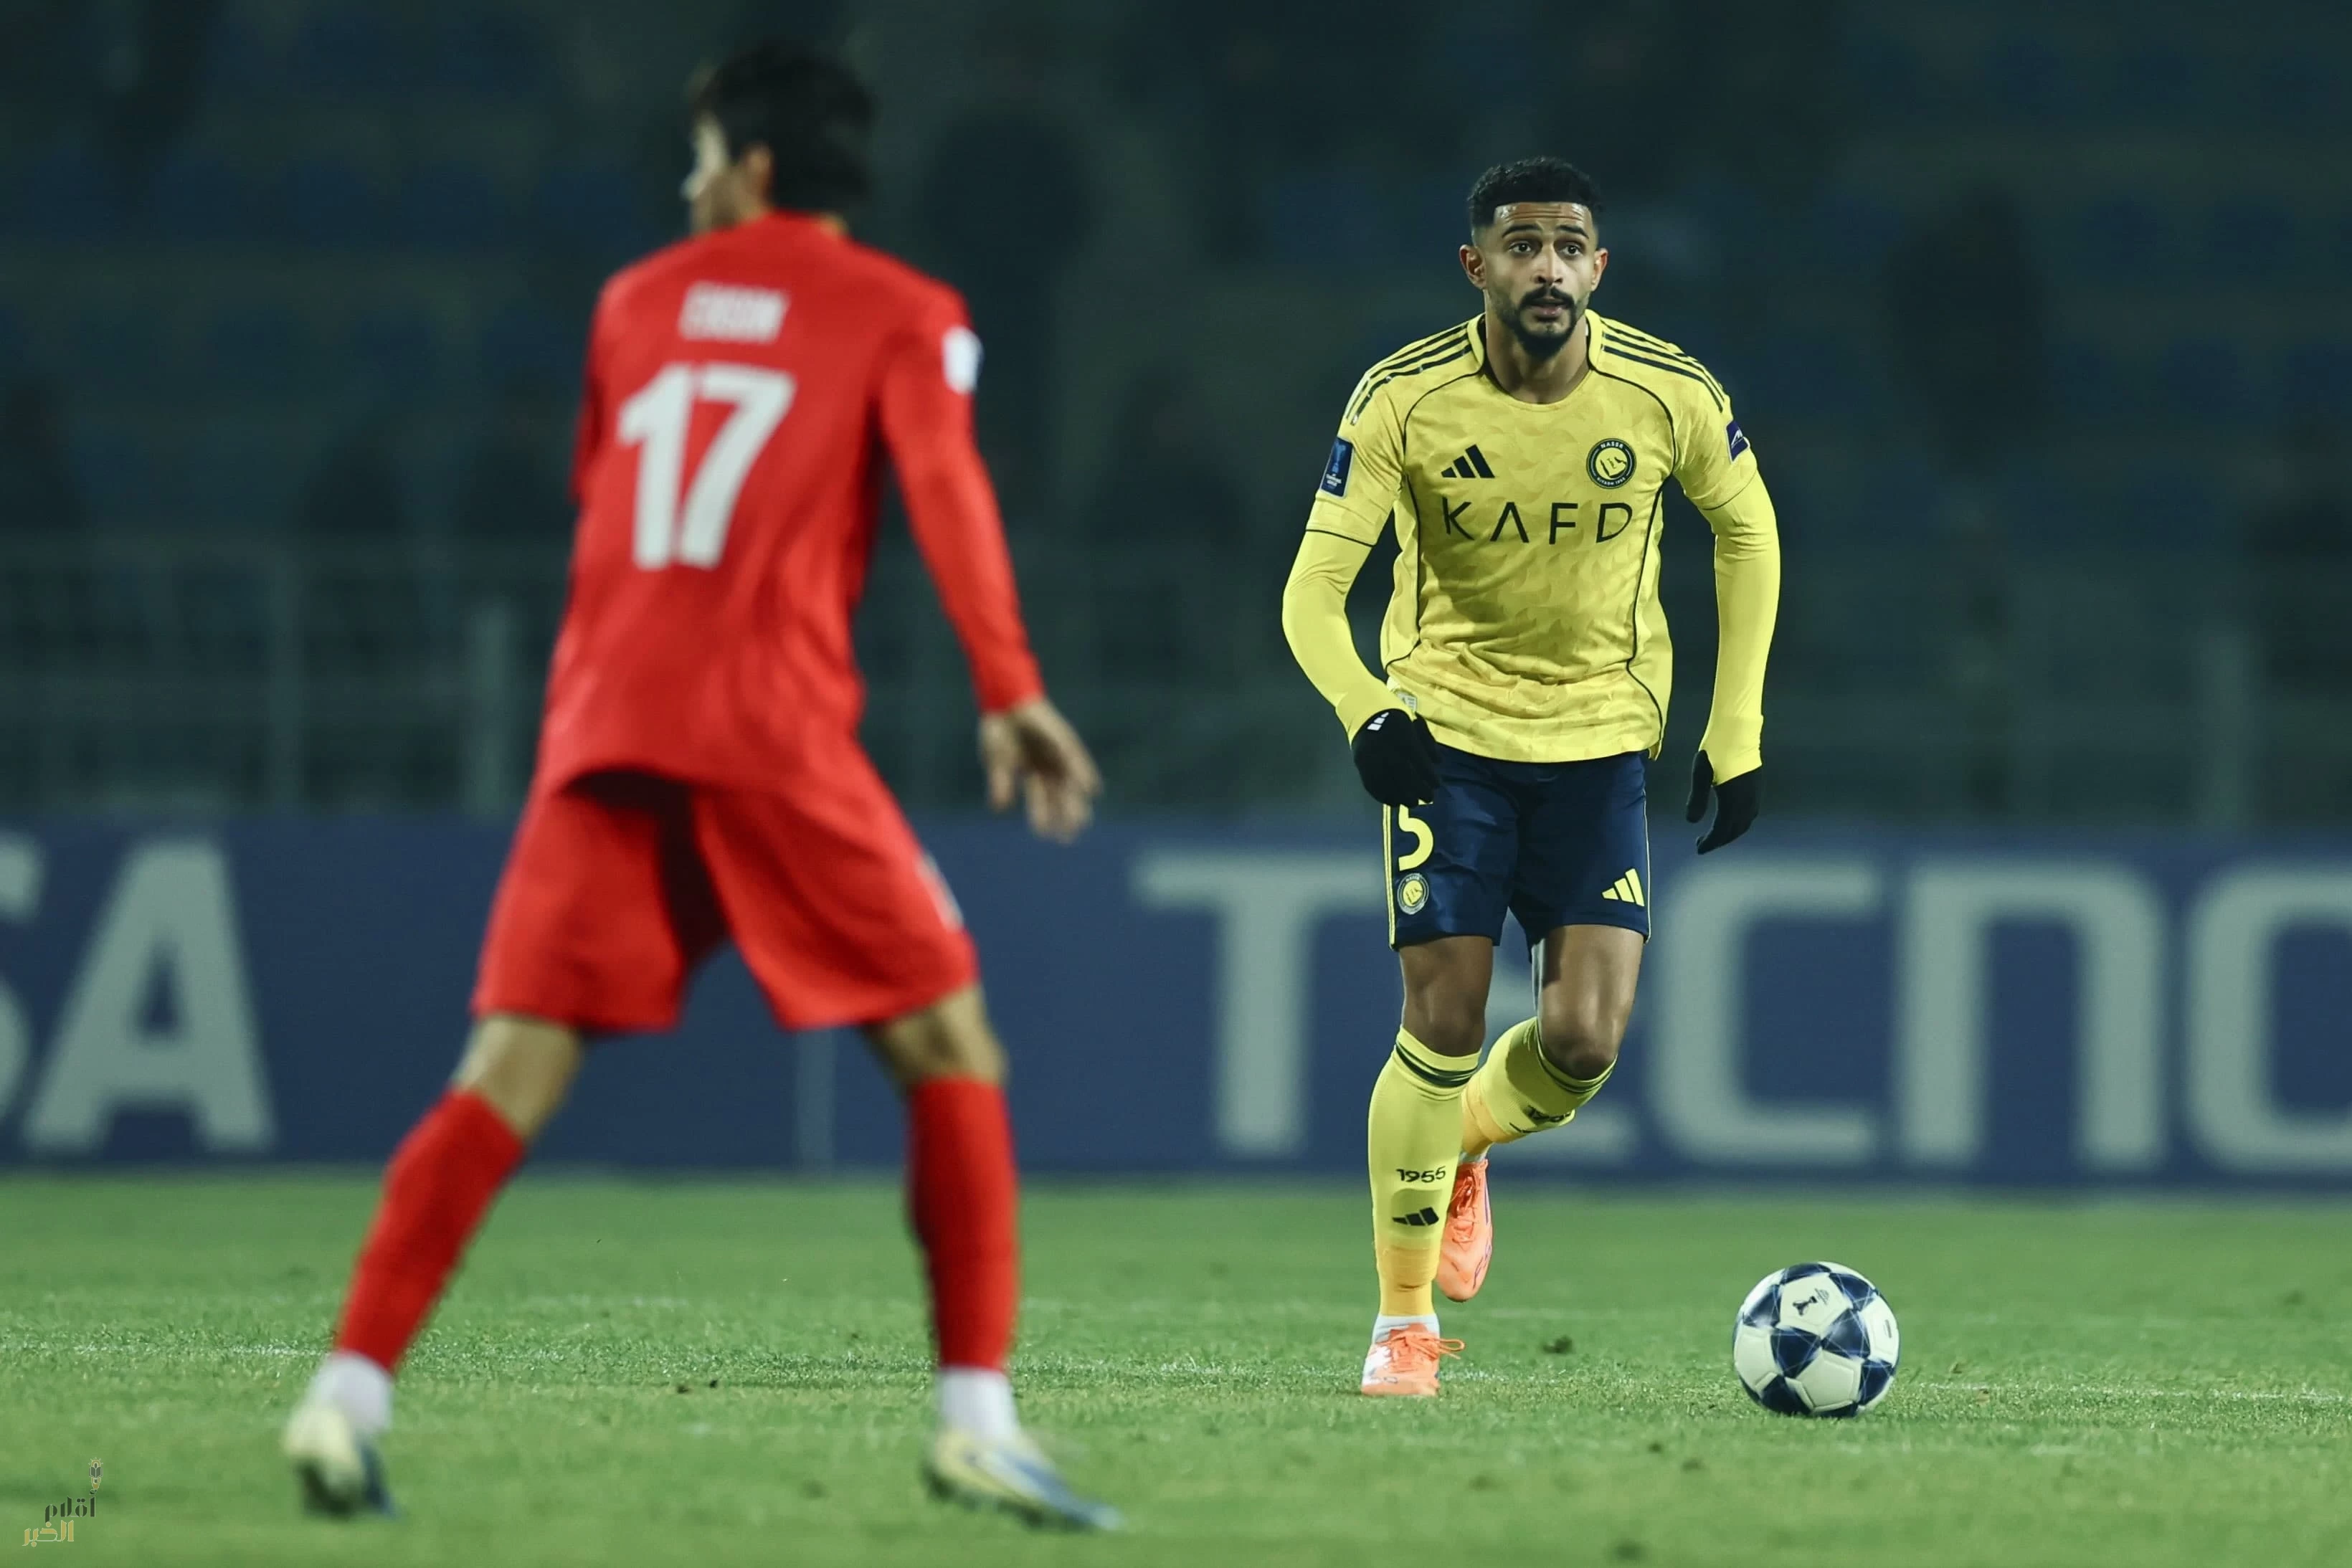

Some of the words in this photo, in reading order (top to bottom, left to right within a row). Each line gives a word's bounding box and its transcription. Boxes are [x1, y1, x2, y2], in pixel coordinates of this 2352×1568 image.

[617, 362, 796, 571] 17
[1441, 496, 1633, 545] KAFD
[1398, 797, 1433, 871] 5
[0, 833, 277, 1151] A
[1132, 853, 2352, 1167] TCNO
[1395, 1166, 1446, 1183] 1955
